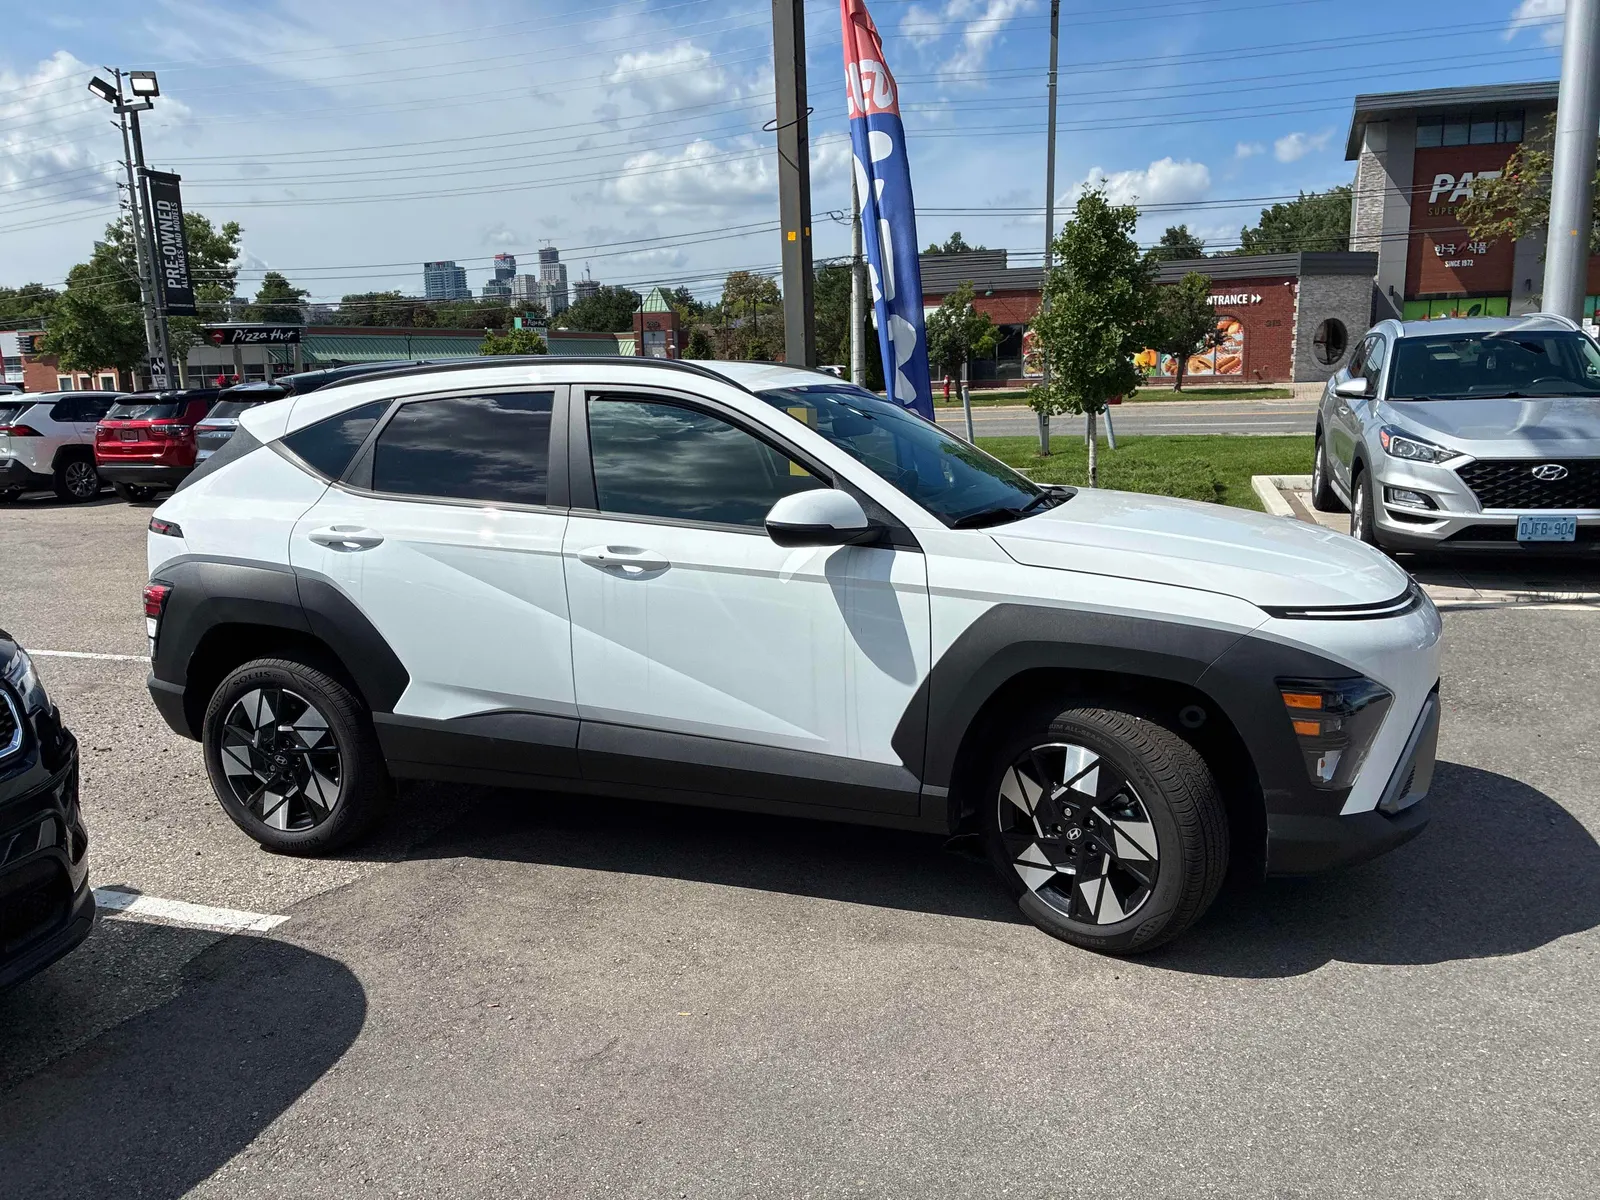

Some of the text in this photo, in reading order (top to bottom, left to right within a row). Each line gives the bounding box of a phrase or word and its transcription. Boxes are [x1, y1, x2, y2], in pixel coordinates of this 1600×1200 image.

[157, 200, 181, 289] PRE-OWNED
[170, 202, 188, 289] ALL MAKES AND MODELS
[1434, 242, 1488, 256] 한국 식품
[1444, 259, 1474, 268] SINCE 1972
[1206, 293, 1248, 306] NTRANCE
[232, 328, 296, 342] Pizza Hut
[233, 671, 271, 688] SOLUS
